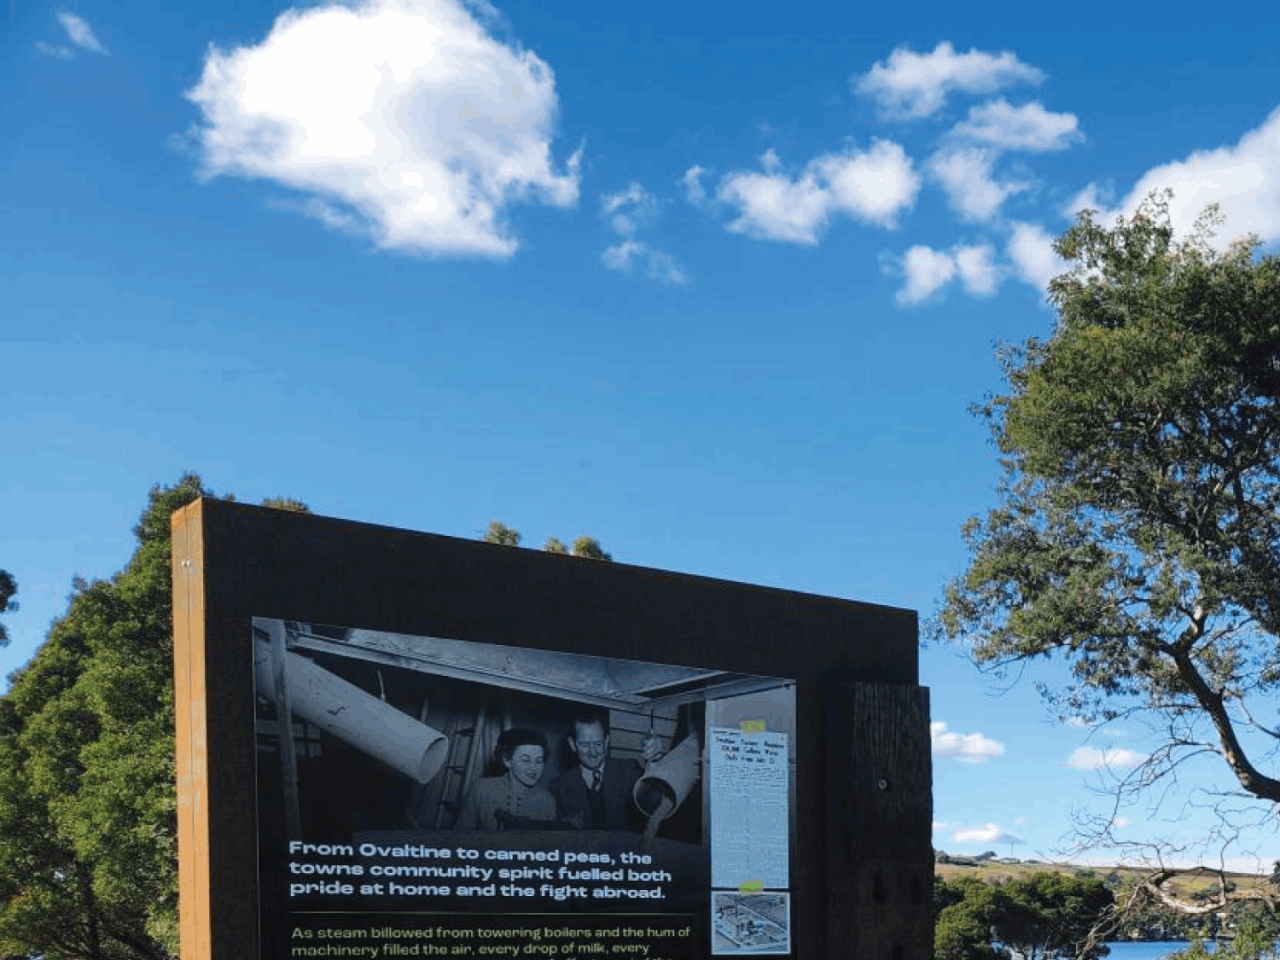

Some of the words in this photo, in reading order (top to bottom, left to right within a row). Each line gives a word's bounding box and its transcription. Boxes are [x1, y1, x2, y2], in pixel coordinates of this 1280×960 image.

[289, 841, 353, 855] From
[359, 843, 451, 858] Ovaltine
[455, 848, 479, 859] to
[484, 849, 559, 861] canned
[564, 852, 615, 864] peas,
[619, 852, 651, 864] the
[289, 863, 364, 875] towns
[369, 865, 493, 879] community
[498, 866, 553, 880] spirit
[557, 867, 624, 880] fuelled
[627, 869, 671, 881] both
[290, 881, 354, 895] pride
[359, 883, 383, 895] at
[389, 883, 450, 895] home
[455, 884, 496, 896] and
[499, 884, 535, 897] the
[539, 884, 588, 900] fight
[592, 886, 665, 898] abroad.
[291, 927, 313, 938] As
[317, 929, 367, 938] steam
[370, 927, 433, 938] billowed
[436, 927, 473, 938] from
[476, 928, 541, 940] towering
[544, 927, 591, 938] boilers
[595, 927, 619, 937] and
[622, 927, 644, 937] the
[646, 928, 675, 937] hum
[678, 926, 690, 937] of
[291, 945, 379, 957] machinery
[382, 943, 419, 955] filled
[422, 944, 448, 955] the
[451, 944, 474, 955] air,
[478, 945, 519, 956] every
[522, 944, 557, 955] drop
[561, 941, 574, 953] of
[578, 942, 608, 953] milk,
[612, 944, 649, 954] every
